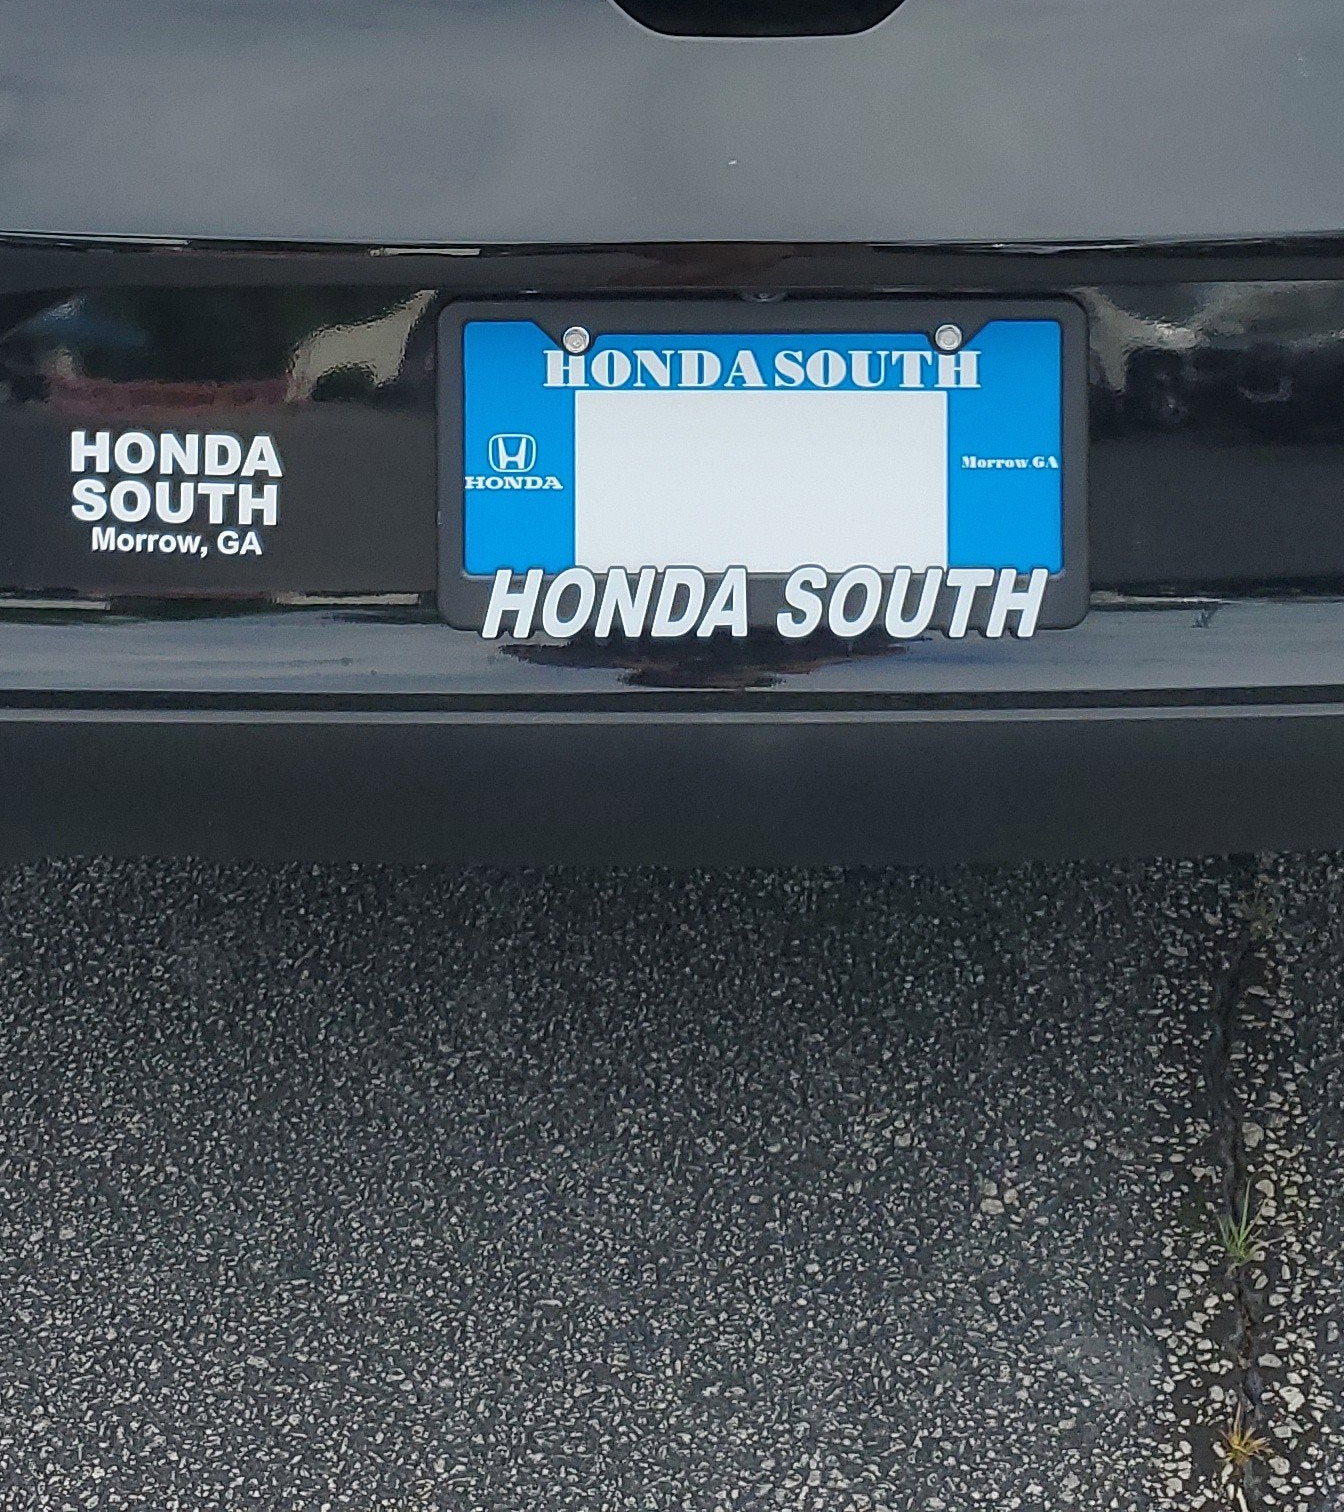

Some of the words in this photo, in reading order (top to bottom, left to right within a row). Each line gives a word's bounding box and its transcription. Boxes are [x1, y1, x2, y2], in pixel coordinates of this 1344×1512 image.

[543, 349, 767, 388] HONDA
[774, 349, 982, 389] SOUTH
[71, 431, 283, 478] HONDA
[1032, 455, 1059, 469] GA
[71, 478, 278, 526] SOUTH
[465, 476, 563, 490] HONDA
[92, 526, 208, 559] Morrow,
[217, 530, 263, 555] GA
[480, 567, 748, 639] HONDA
[775, 567, 1048, 638] SOUTH
